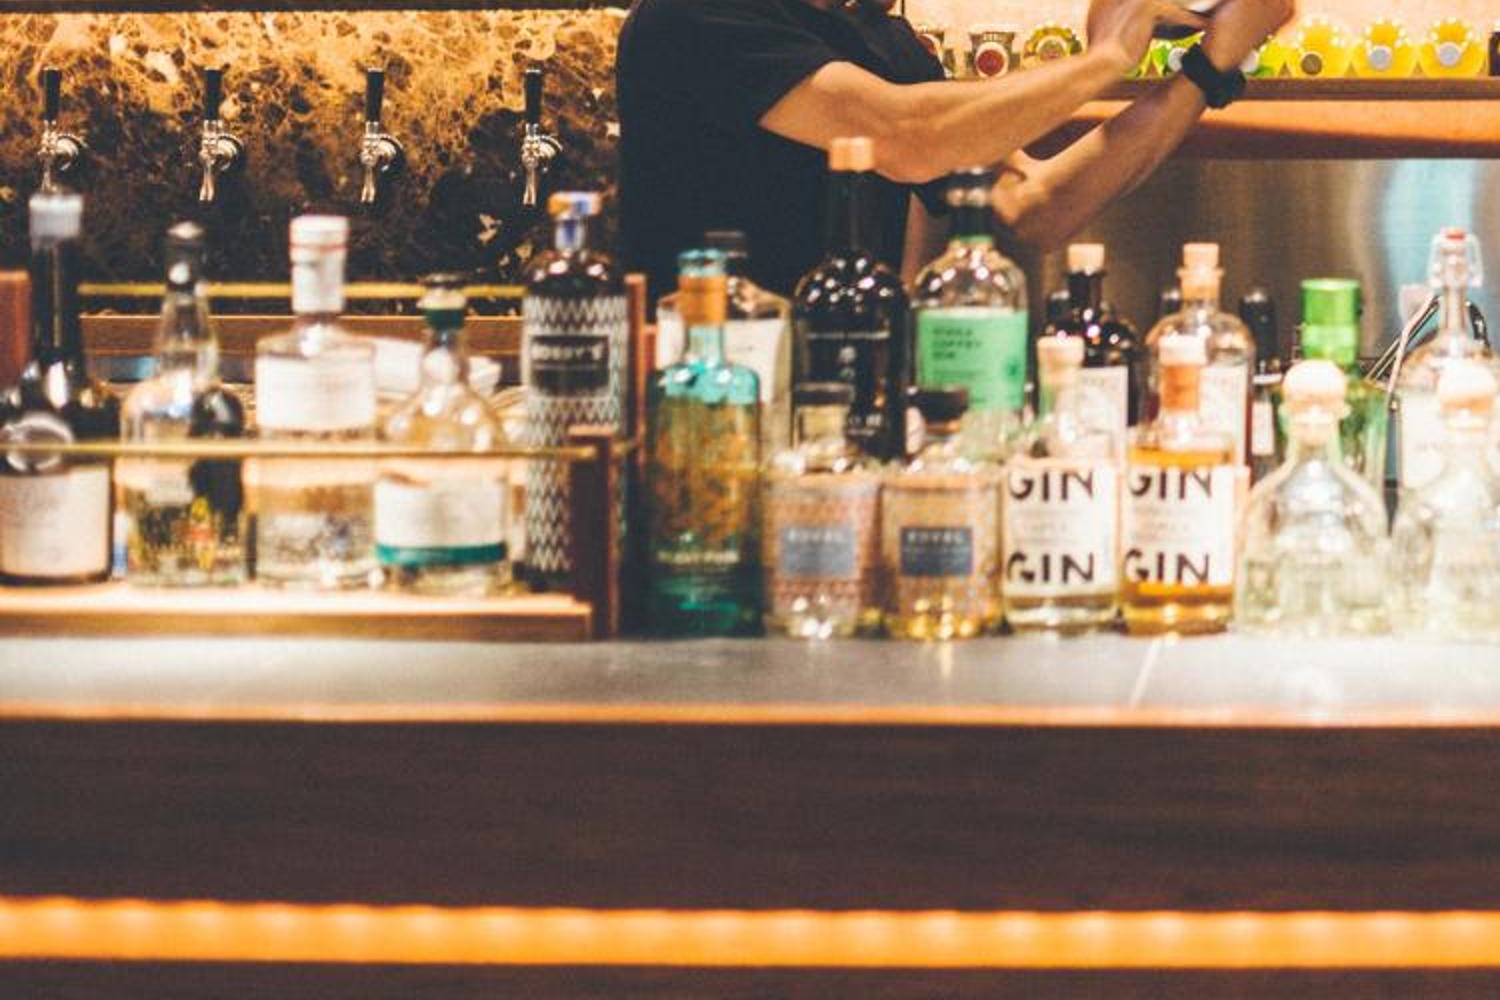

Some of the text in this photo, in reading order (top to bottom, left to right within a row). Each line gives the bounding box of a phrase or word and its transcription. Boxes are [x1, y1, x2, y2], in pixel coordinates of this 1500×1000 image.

[1008, 472, 1094, 502] GIN
[1127, 472, 1212, 502] GIN
[1007, 551, 1094, 583] GIN
[1124, 548, 1210, 583] GIN
